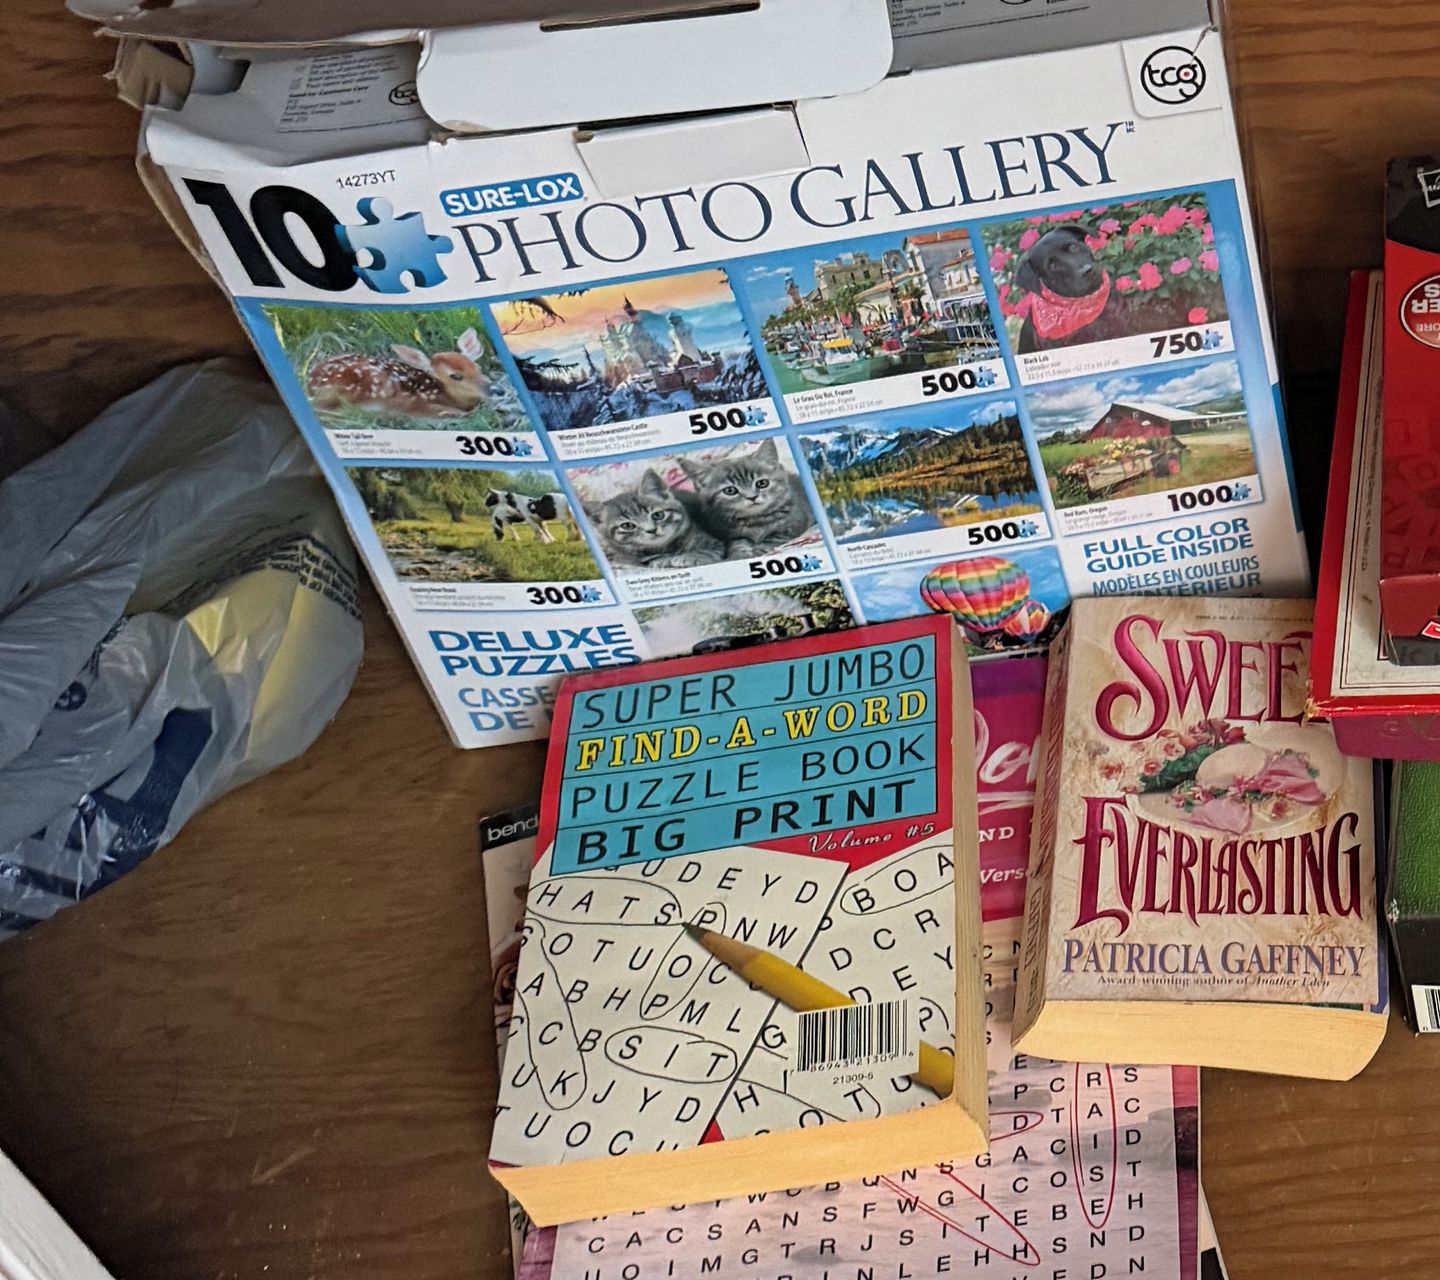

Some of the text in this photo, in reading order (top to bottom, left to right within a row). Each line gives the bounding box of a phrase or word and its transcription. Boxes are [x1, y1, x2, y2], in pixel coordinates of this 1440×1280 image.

[336, 169, 397, 190] 14273YT
[446, 174, 577, 214] SURE-LOX
[451, 122, 1125, 283] PHOTO GALLERY
[182, 177, 360, 292] 10
[1150, 330, 1202, 359] 750
[921, 369, 977, 397] 500
[688, 408, 748, 436] 500
[456, 436, 515, 456] 300
[1168, 485, 1232, 512] 1000
[968, 522, 1020, 546] 500
[1083, 535, 1152, 558] FULL
[1156, 517, 1250, 545] COLOR
[1086, 533, 1254, 574] GUIDE INSIDE
[749, 556, 802, 579] 500
[1093, 555, 1260, 596] MODÈLES EN COULEURS
[526, 586, 583, 605] 300
[428, 623, 633, 653] DELUXE
[442, 646, 643, 678] PUZZLES
[1095, 614, 1312, 741] SWEE
[582, 643, 926, 729] SUPER JUMBO
[574, 689, 928, 772] FIND-A-WORD
[572, 760, 761, 818] PUZZLE
[801, 733, 928, 783] BOOK
[577, 778, 916, 866] BIG PRINT
[807, 820, 936, 853] Volume #5
[1071, 796, 1363, 938] EVERLASTING
[1061, 938, 1367, 978] PATRICIA GAFFNEY
